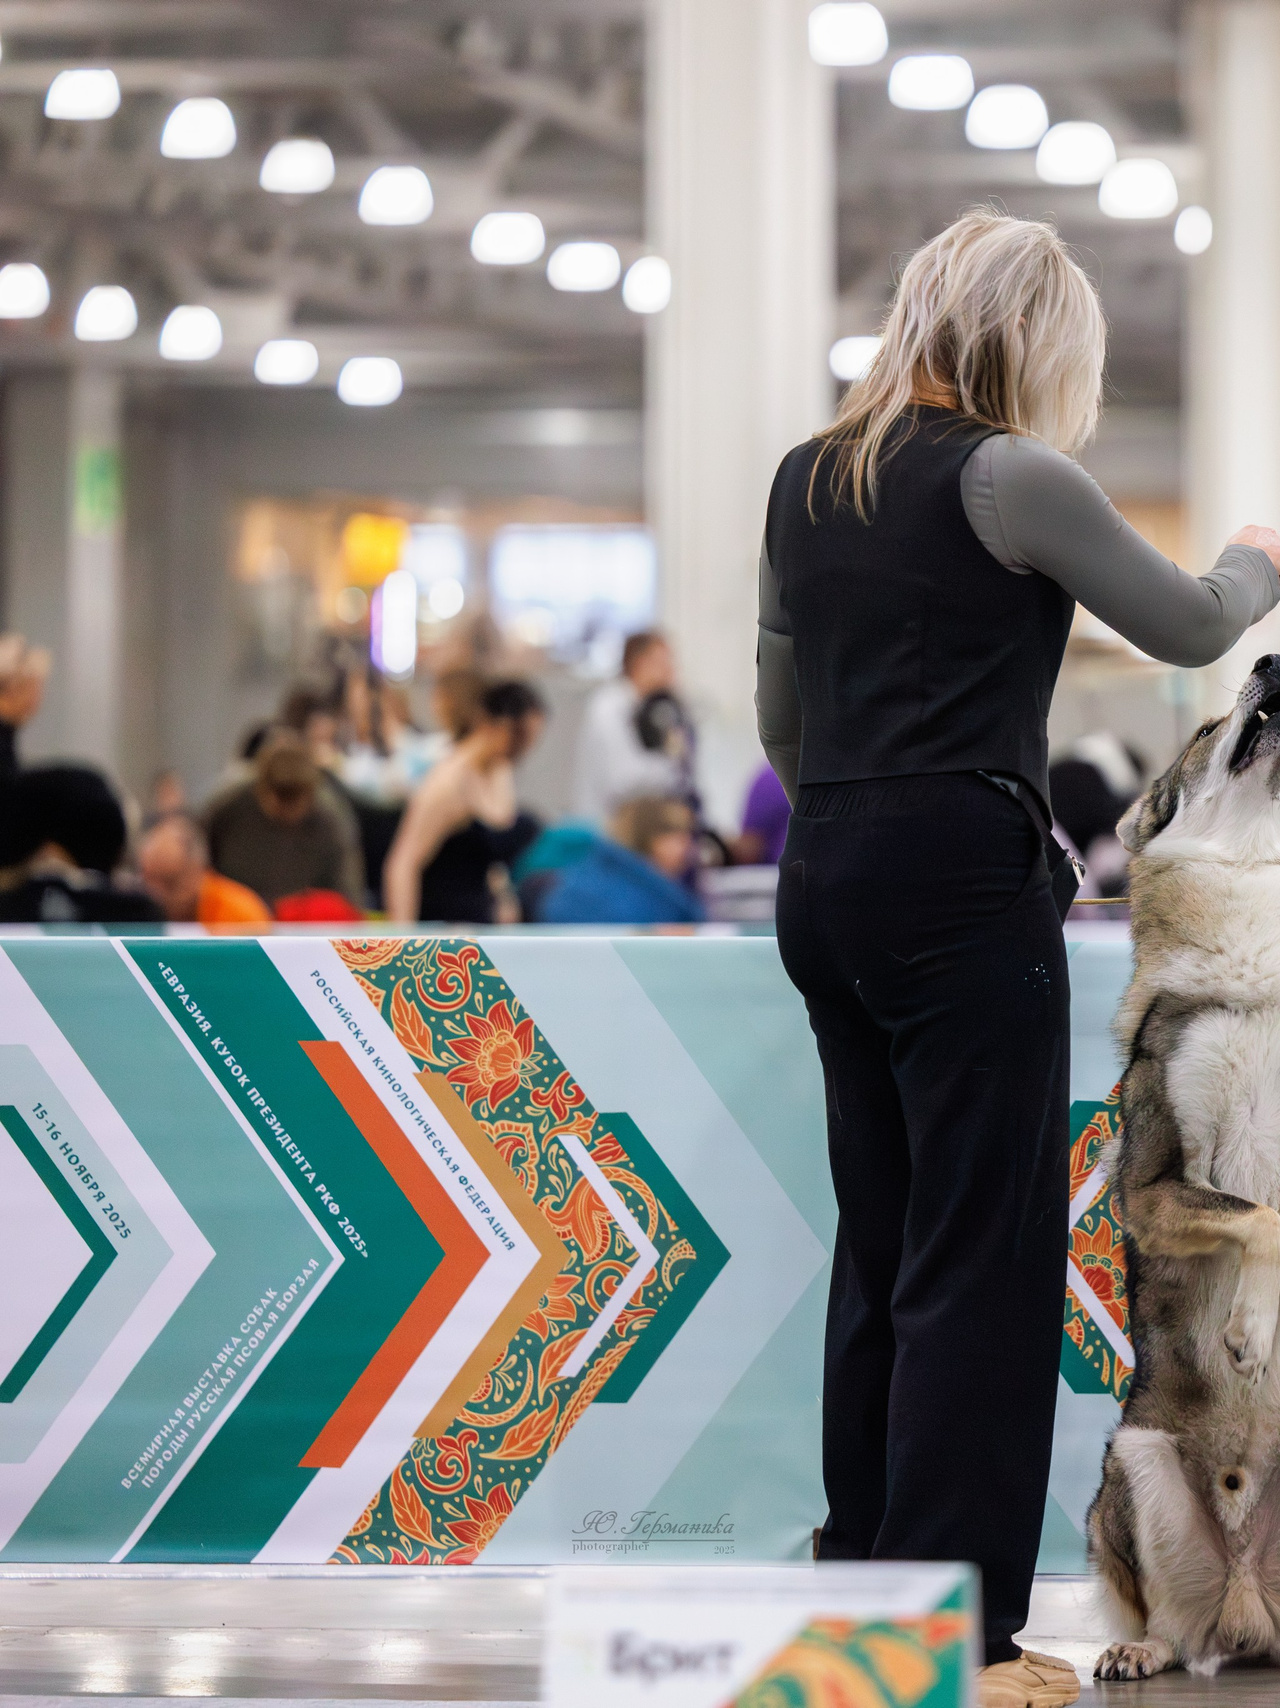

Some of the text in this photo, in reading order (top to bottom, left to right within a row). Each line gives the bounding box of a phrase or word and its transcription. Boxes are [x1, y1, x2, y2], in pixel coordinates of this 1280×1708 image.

[32, 1103, 131, 1239] 15-16 НОЯБРЯ 2025
[157, 961, 369, 1258] «ЕВРАЗИЯ. КУБОК ПРЕЗИДЕНТА РКФ 2025»
[310, 970, 516, 1251] РОССИЙСКАЯ КИНОЛОГИЧЕСКАЯ ФЕДЕРАЦИЯ
[121, 1287, 278, 1489] ВСЕМИРНАЯ ВЫСТАВКА СОБАК
[141, 1258, 320, 1488] ПОРОДЫ РУССКАЯ ПСОВАЯ БОРЗАЯ
